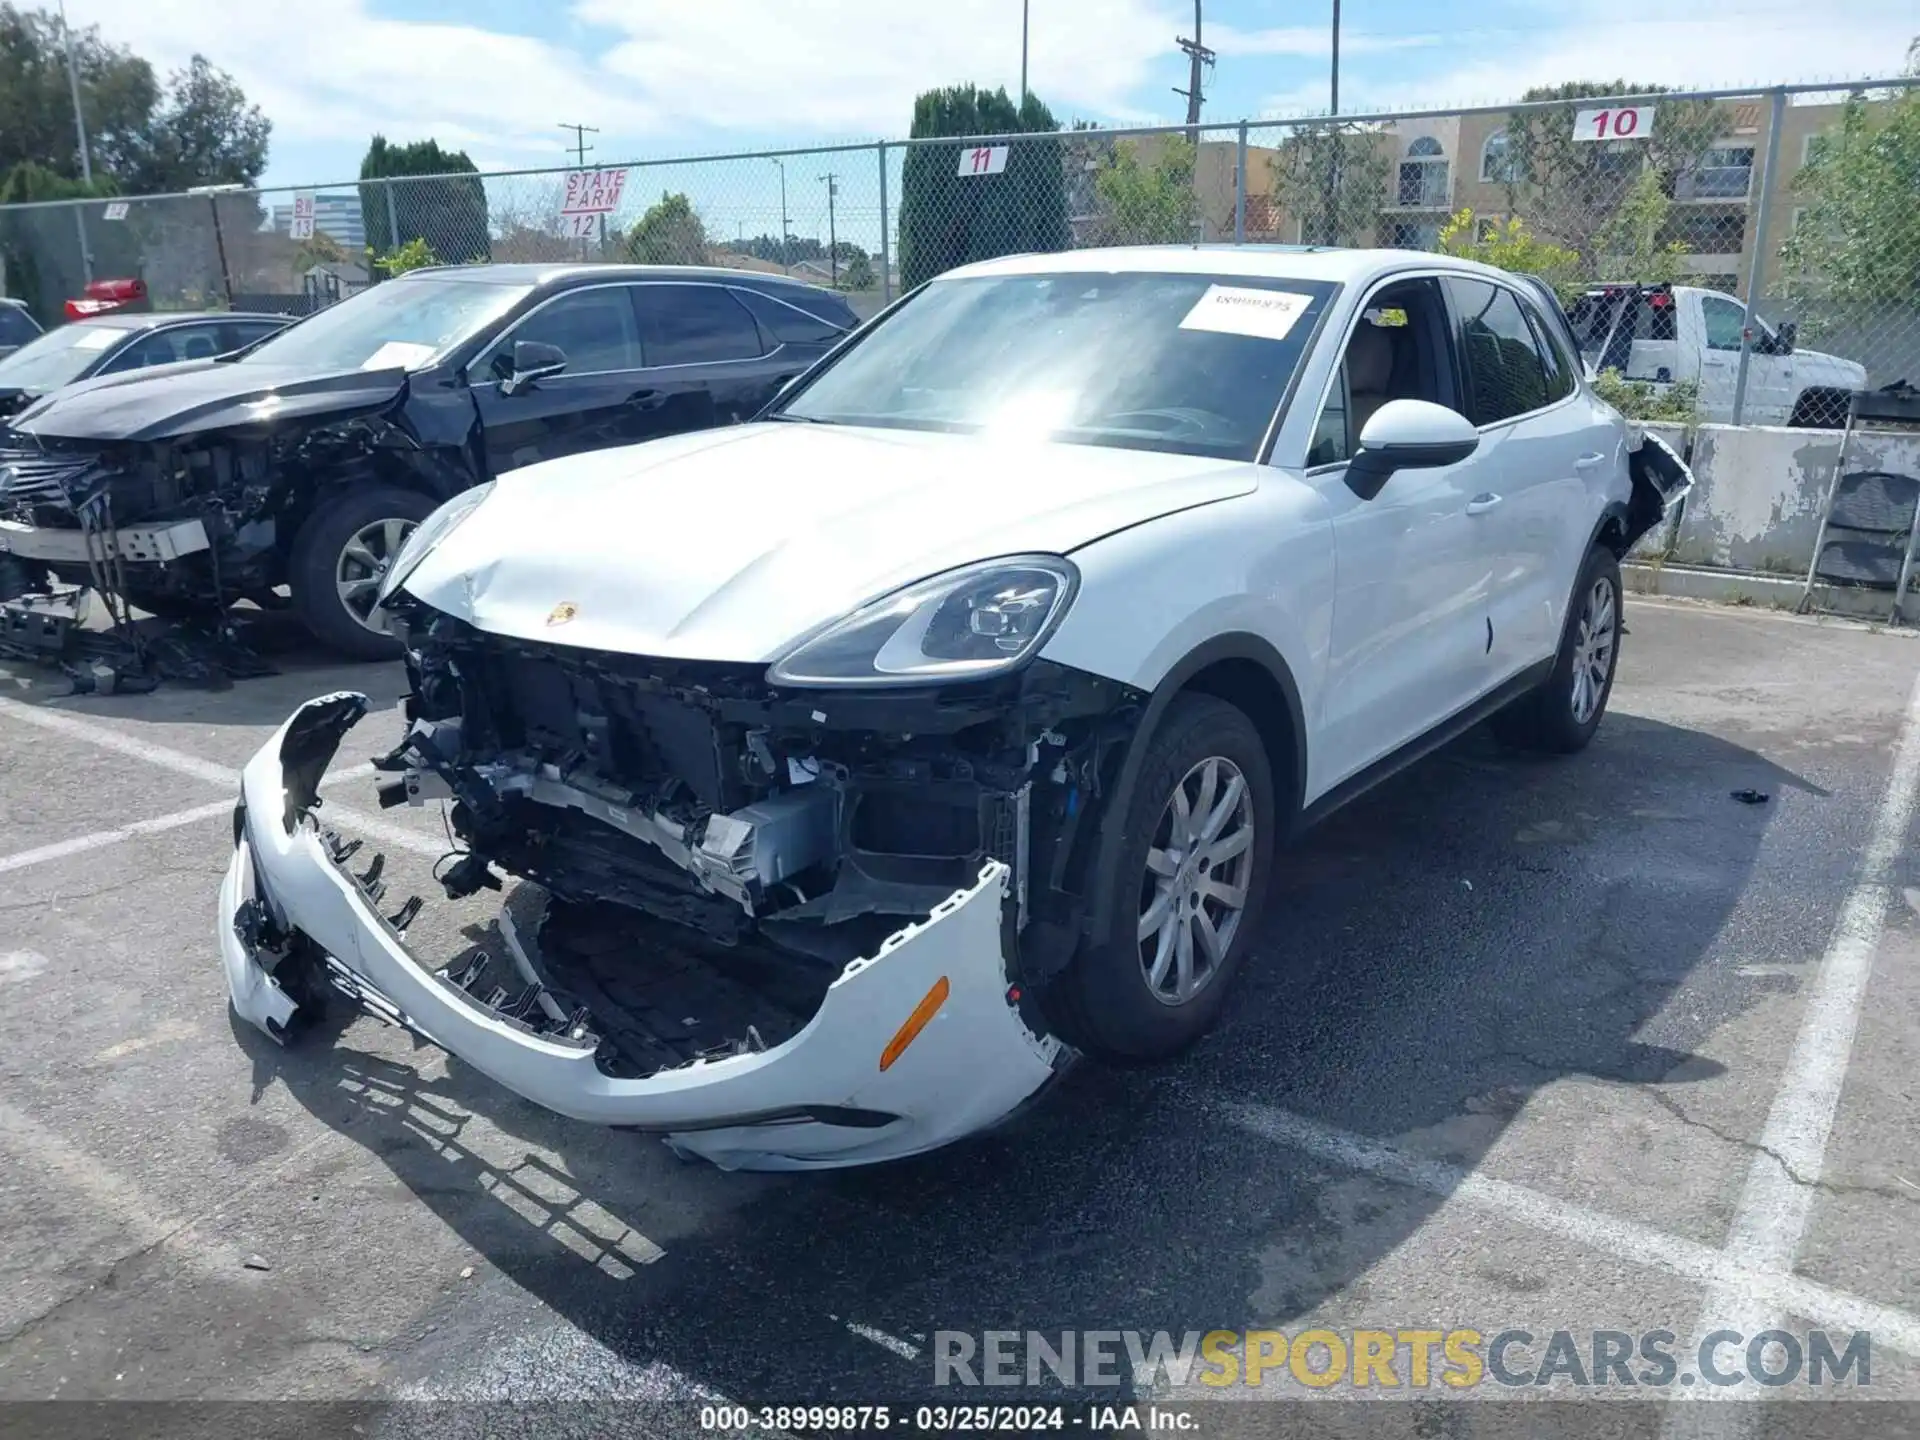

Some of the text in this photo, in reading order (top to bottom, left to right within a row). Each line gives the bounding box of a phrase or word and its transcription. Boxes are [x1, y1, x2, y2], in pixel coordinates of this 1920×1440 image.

[1592, 108, 1638, 138] 10
[971, 147, 992, 173] 11
[567, 168, 628, 190] STATE
[564, 188, 621, 208] FARM
[296, 219, 311, 237] 13
[573, 214, 595, 236] 12
